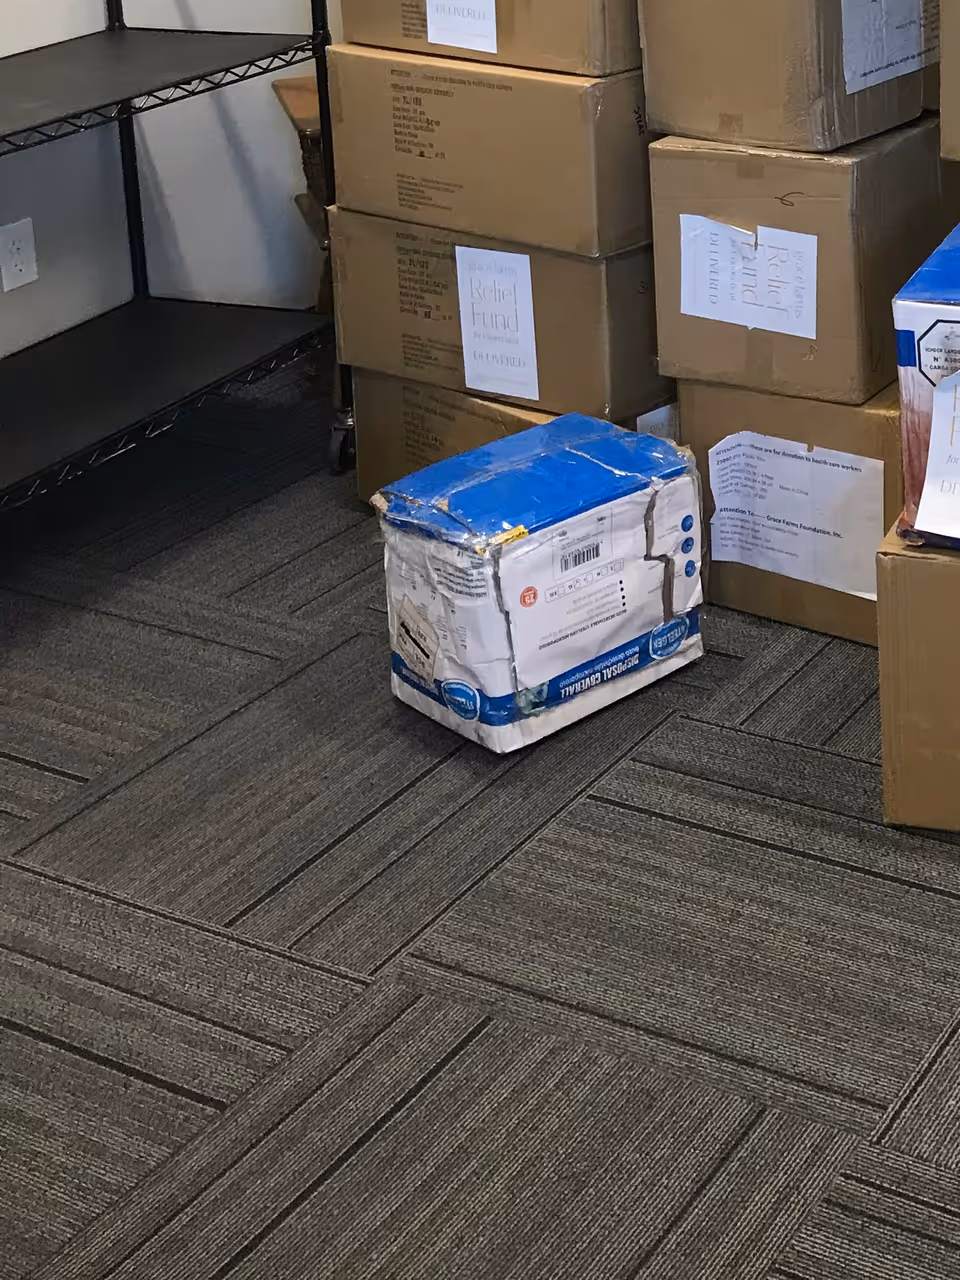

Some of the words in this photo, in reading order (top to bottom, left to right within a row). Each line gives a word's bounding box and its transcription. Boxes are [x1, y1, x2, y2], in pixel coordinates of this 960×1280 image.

[741, 242, 765, 307] Fund
[470, 277, 518, 306] Relief
[471, 302, 519, 333] Fund
[719, 507, 747, 515] Attention
[602, 653, 640, 680] DISPOSAL
[560, 676, 601, 698] COVERALL
